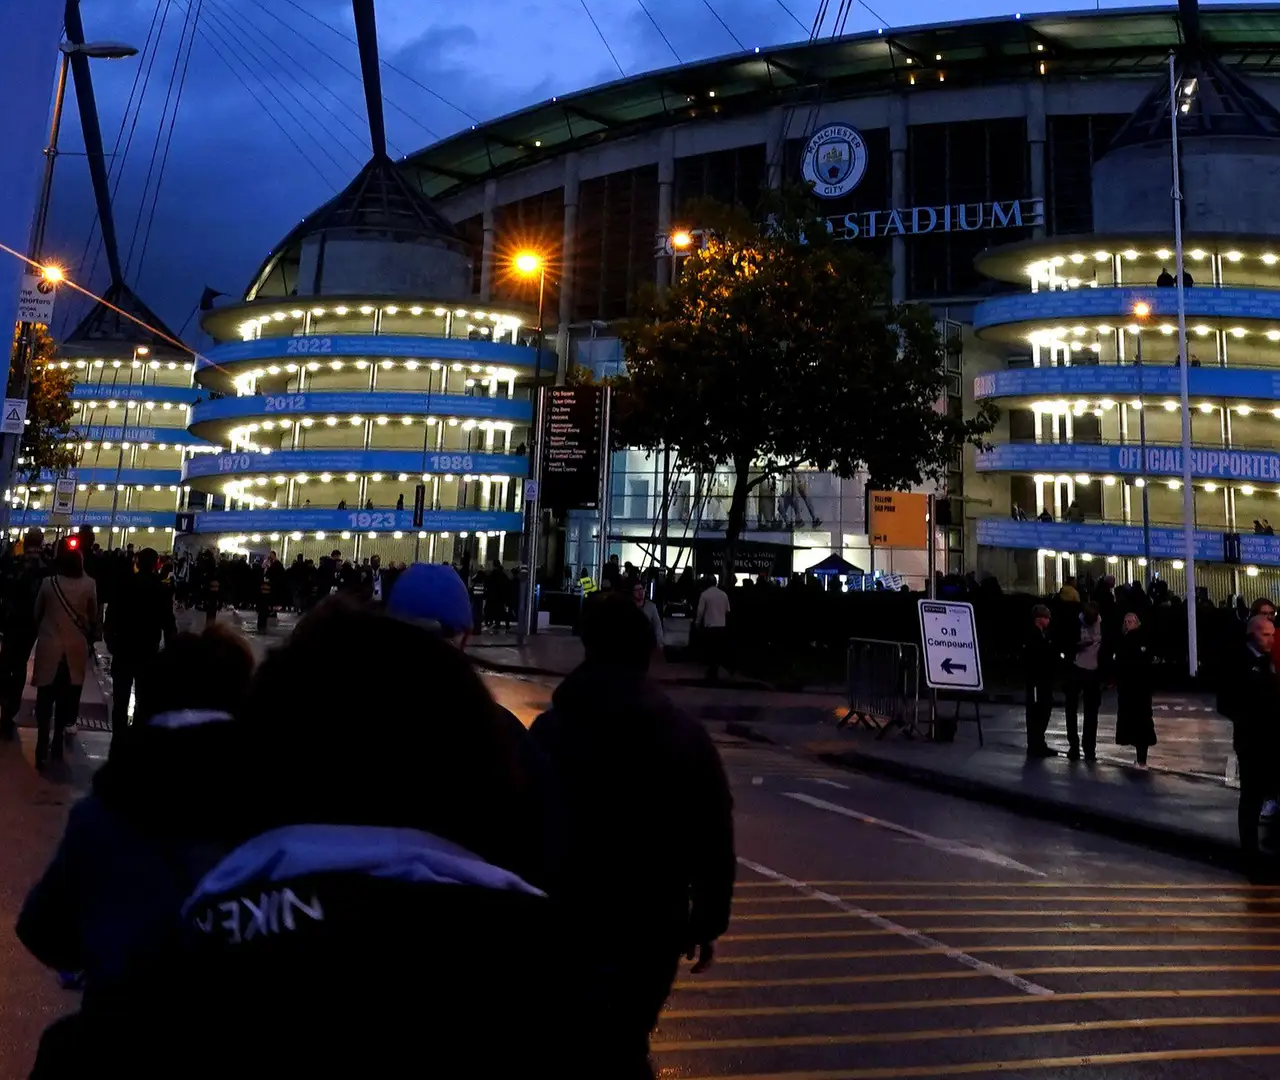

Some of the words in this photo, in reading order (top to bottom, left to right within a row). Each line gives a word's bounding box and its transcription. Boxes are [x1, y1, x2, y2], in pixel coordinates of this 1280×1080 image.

[807, 127, 861, 154] MANCHESTER
[824, 186, 843, 194] CITY
[843, 200, 1023, 241] STADIUM
[287, 338, 332, 353] 2022
[264, 395, 305, 411] 2012
[219, 455, 250, 471] 1970
[1118, 447, 1184, 472] OFFICIAL
[348, 512, 397, 528] 1923
[927, 637, 973, 649] Compound
[218, 886, 326, 946] NIKE
